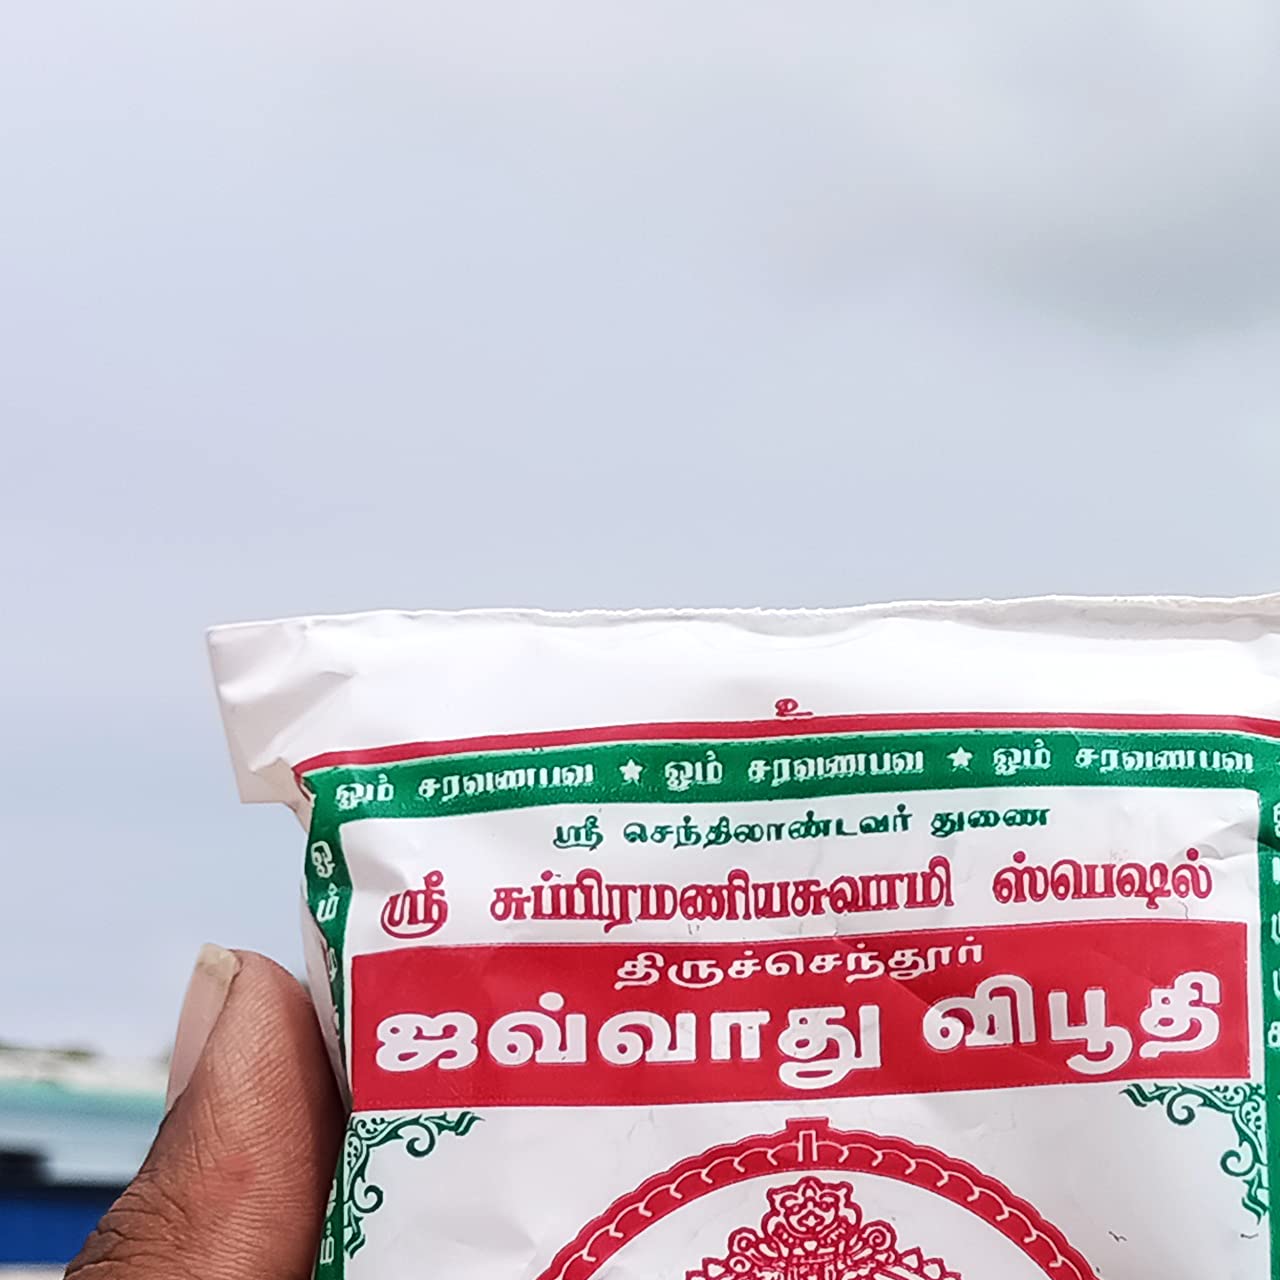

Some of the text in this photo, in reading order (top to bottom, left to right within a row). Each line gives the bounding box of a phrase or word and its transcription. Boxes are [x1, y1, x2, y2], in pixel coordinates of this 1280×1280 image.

[336, 738, 1255, 810] ஓம் சரவணபவ ஓம் சரவணபவ ஓம் சரவணபவ
[624, 804, 913, 849] செந்திலாண்டவர்
[931, 807, 1051, 838] துணை
[490, 856, 955, 934] சுப்பிரமணியசுவாமி
[992, 847, 1213, 911] ஸ்பெஷல்
[614, 935, 984, 991] திருச்செந்தூர்
[375, 991, 882, 1090] ஜவ்வாது
[921, 969, 1222, 1076] விபூதி
